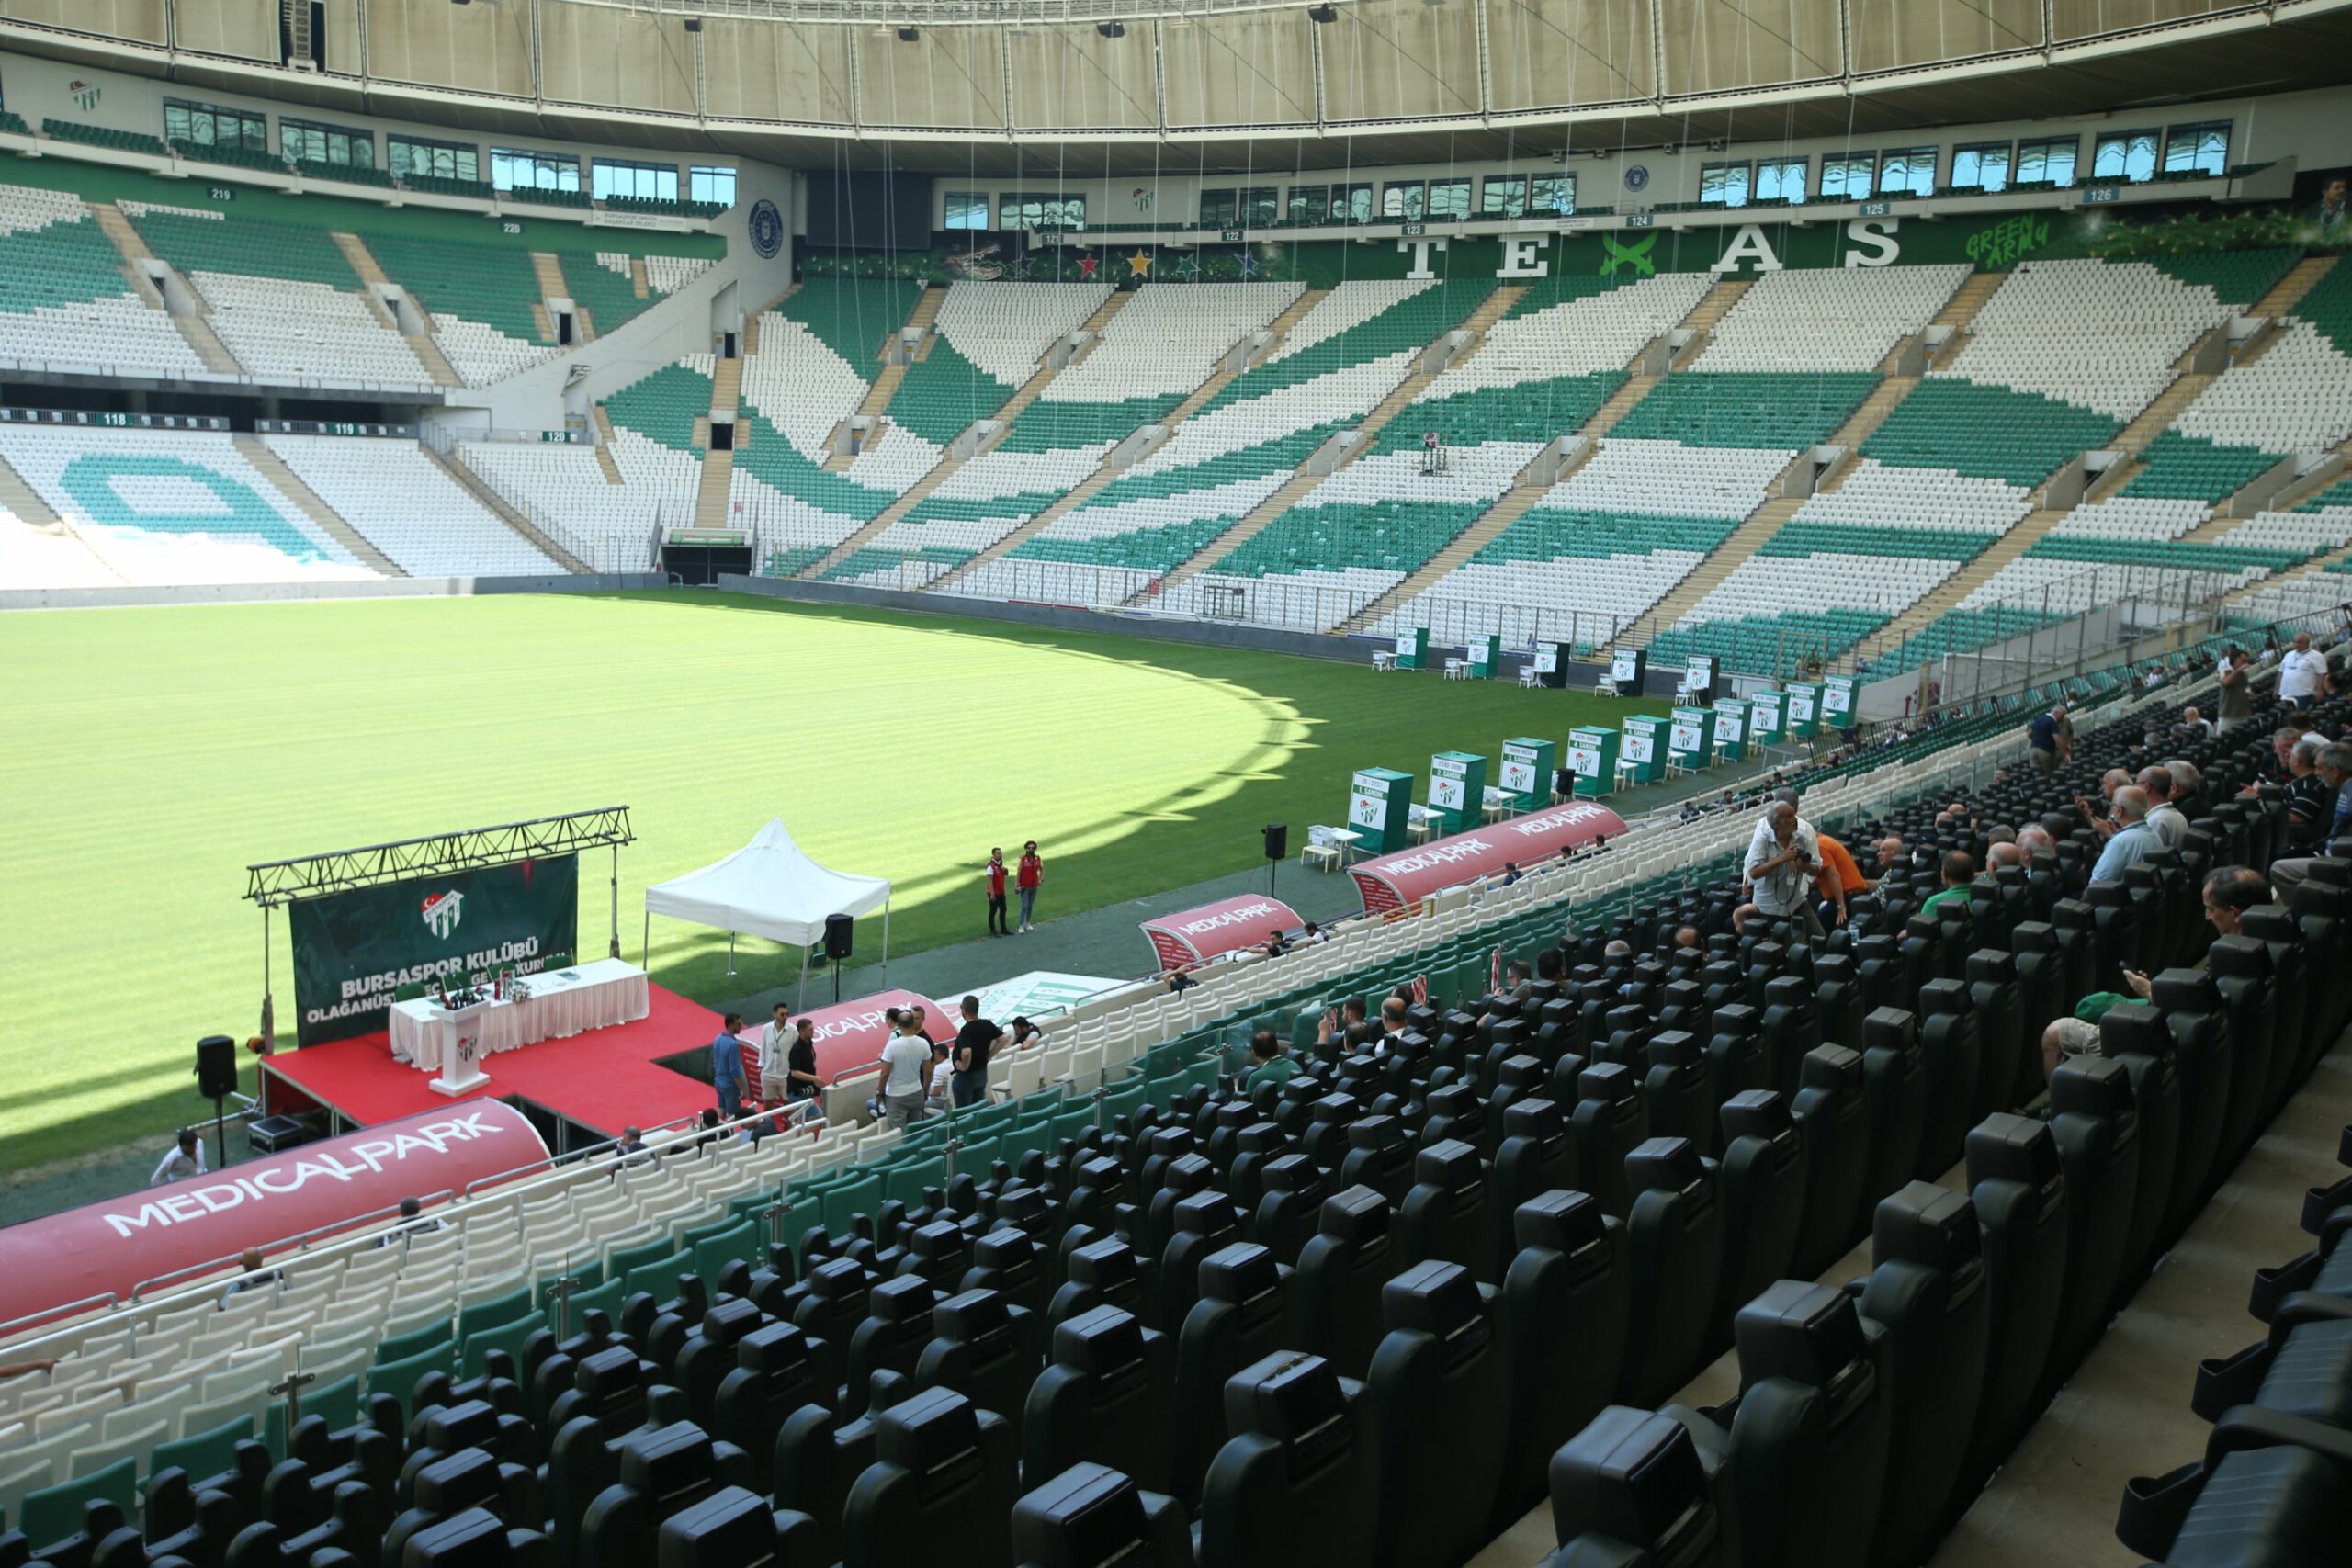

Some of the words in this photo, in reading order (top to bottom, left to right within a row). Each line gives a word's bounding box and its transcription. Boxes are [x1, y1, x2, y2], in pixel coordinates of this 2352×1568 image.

[212, 188, 231, 200] 219
[2090, 189, 2112, 201] 126
[1865, 204, 1884, 215] 125
[1632, 217, 1647, 226] 124
[503, 223, 520, 234] 220
[1406, 225, 1420, 235] 123
[1046, 235, 1058, 243] 121
[1226, 231, 1239, 241] 122
[1966, 212, 2034, 260] GREEN
[1985, 221, 2049, 269] ARMY
[105, 413, 126, 426] 118
[335, 423, 354, 435] 119
[548, 431, 565, 442] 120
[1510, 804, 1606, 836] MEDICALPARK
[1377, 838, 1493, 876] MEDICALPARK
[1179, 902, 1278, 935] MEDICALPARK
[342, 957, 463, 999] BURSASPOR
[466, 936, 538, 971] KULÜBÜ
[104, 1112, 504, 1238] MEDICALPARK
